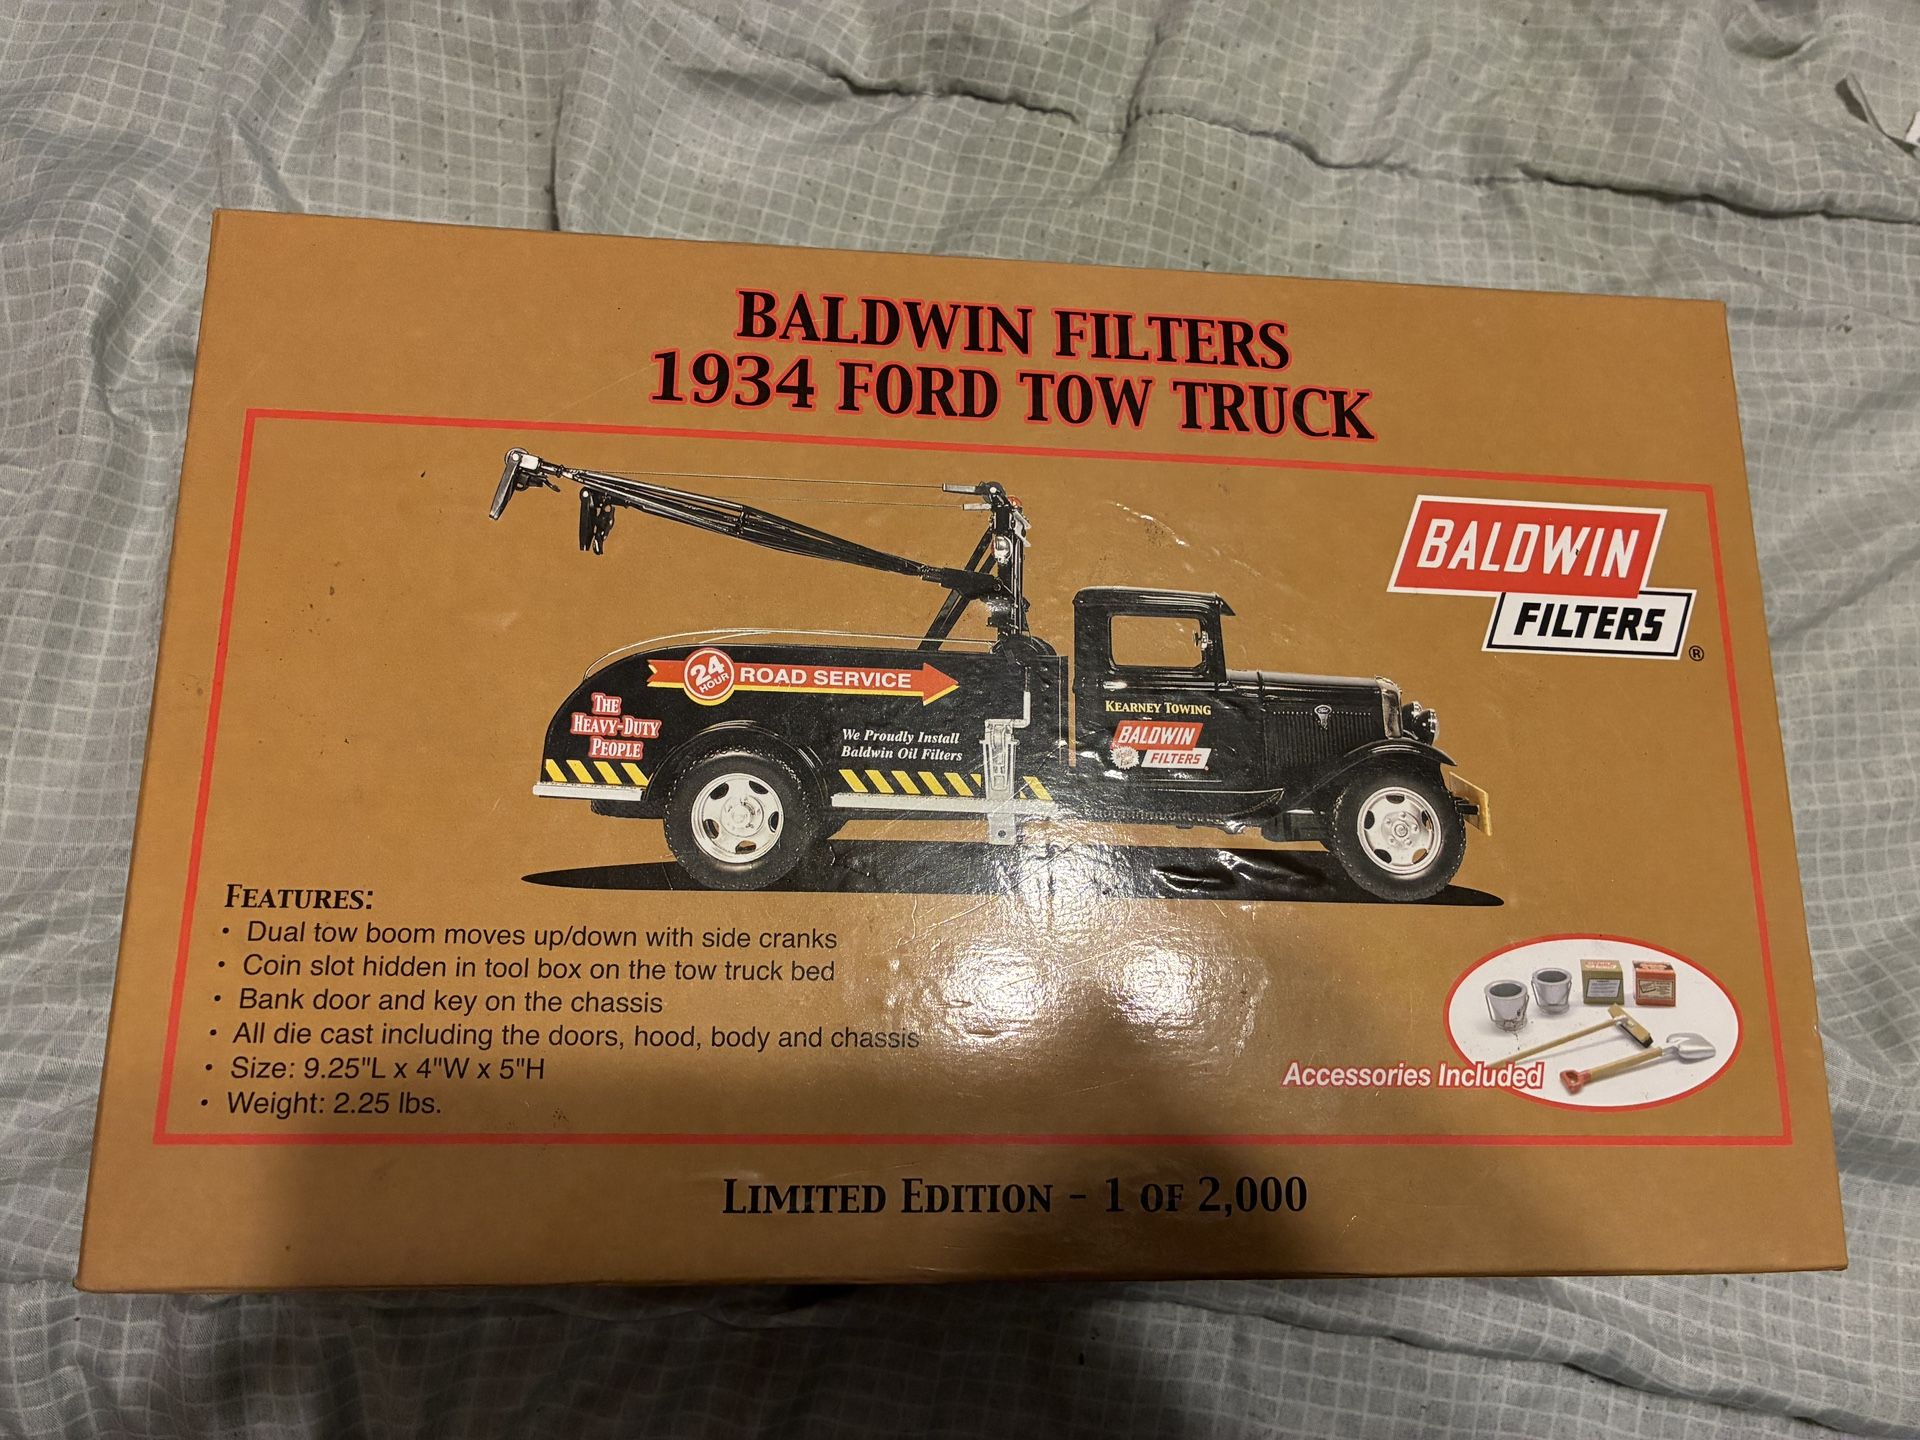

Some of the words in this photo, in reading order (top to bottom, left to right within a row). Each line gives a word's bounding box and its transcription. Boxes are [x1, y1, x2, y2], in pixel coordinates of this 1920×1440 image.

[737, 289, 1033, 356] BALDWIN
[1054, 308, 1291, 370] FILTERS
[650, 349, 815, 411] 1934
[838, 360, 999, 420] FORD
[1017, 371, 1154, 430] TOW
[1172, 380, 1377, 442] TRUCK
[1416, 518, 1640, 578] BALDWIN
[1513, 602, 1666, 641] FILTERS
[690, 655, 725, 687] 24
[699, 672, 729, 693] HOUR
[740, 667, 807, 684] ROAD
[813, 669, 912, 689] SERVICE
[842, 728, 860, 740] We
[864, 729, 914, 745] Proudly
[918, 731, 960, 744] Install
[1118, 726, 1195, 745] BALDWIN
[841, 745, 893, 758] Baldwin
[897, 747, 918, 760] Oil
[921, 748, 963, 761] Filters
[1150, 753, 1202, 764] FILTERS
[224, 883, 373, 910] FEATURES:
[247, 920, 305, 942] Dual
[314, 923, 358, 943] tow
[366, 922, 435, 943] boom
[444, 928, 526, 945] moves
[534, 926, 637, 951] up/down
[645, 927, 693, 947] with
[702, 927, 751, 948] side
[759, 928, 837, 949] cranks
[243, 954, 301, 976] Coin
[310, 955, 354, 976] slot
[363, 955, 447, 977] hidden
[456, 956, 476, 978] in
[485, 957, 529, 978] tool
[538, 958, 581, 979] box
[590, 963, 619, 980] on
[629, 959, 666, 980] the
[675, 961, 717, 981] tow
[725, 960, 783, 981] truck
[791, 960, 835, 982] bed
[239, 987, 305, 1010] Bank
[313, 989, 371, 1010] door
[378, 989, 425, 1011] and
[434, 990, 477, 1016] key
[485, 995, 516, 1012] on
[525, 991, 562, 1012] the
[570, 992, 663, 1013] chassis
[233, 1022, 265, 1044] All
[274, 1023, 311, 1044] die
[320, 1024, 374, 1045] cast
[381, 1024, 493, 1050] including
[502, 1024, 540, 1046] the
[549, 1025, 625, 1050] doors,
[634, 1025, 701, 1050] hood,
[711, 1026, 770, 1052] body
[778, 1027, 823, 1048] and
[830, 1027, 920, 1049] chassis
[230, 1056, 295, 1079] Size:
[303, 1057, 387, 1079] 9.25"L
[393, 1062, 408, 1079] x
[416, 1057, 470, 1079] 4"W
[477, 1063, 491, 1080] x
[499, 1058, 545, 1080] 5"H
[1282, 1062, 1431, 1088] Accessories
[1438, 1062, 1544, 1089] Included
[227, 1091, 325, 1120] Weight:
[333, 1091, 390, 1114] 2.25
[398, 1092, 441, 1114] lbs.
[722, 1178, 886, 1214] LIMITED
[901, 1178, 1053, 1214] EDITION
[1105, 1176, 1124, 1213] 1
[1198, 1176, 1308, 1217] 2,000
